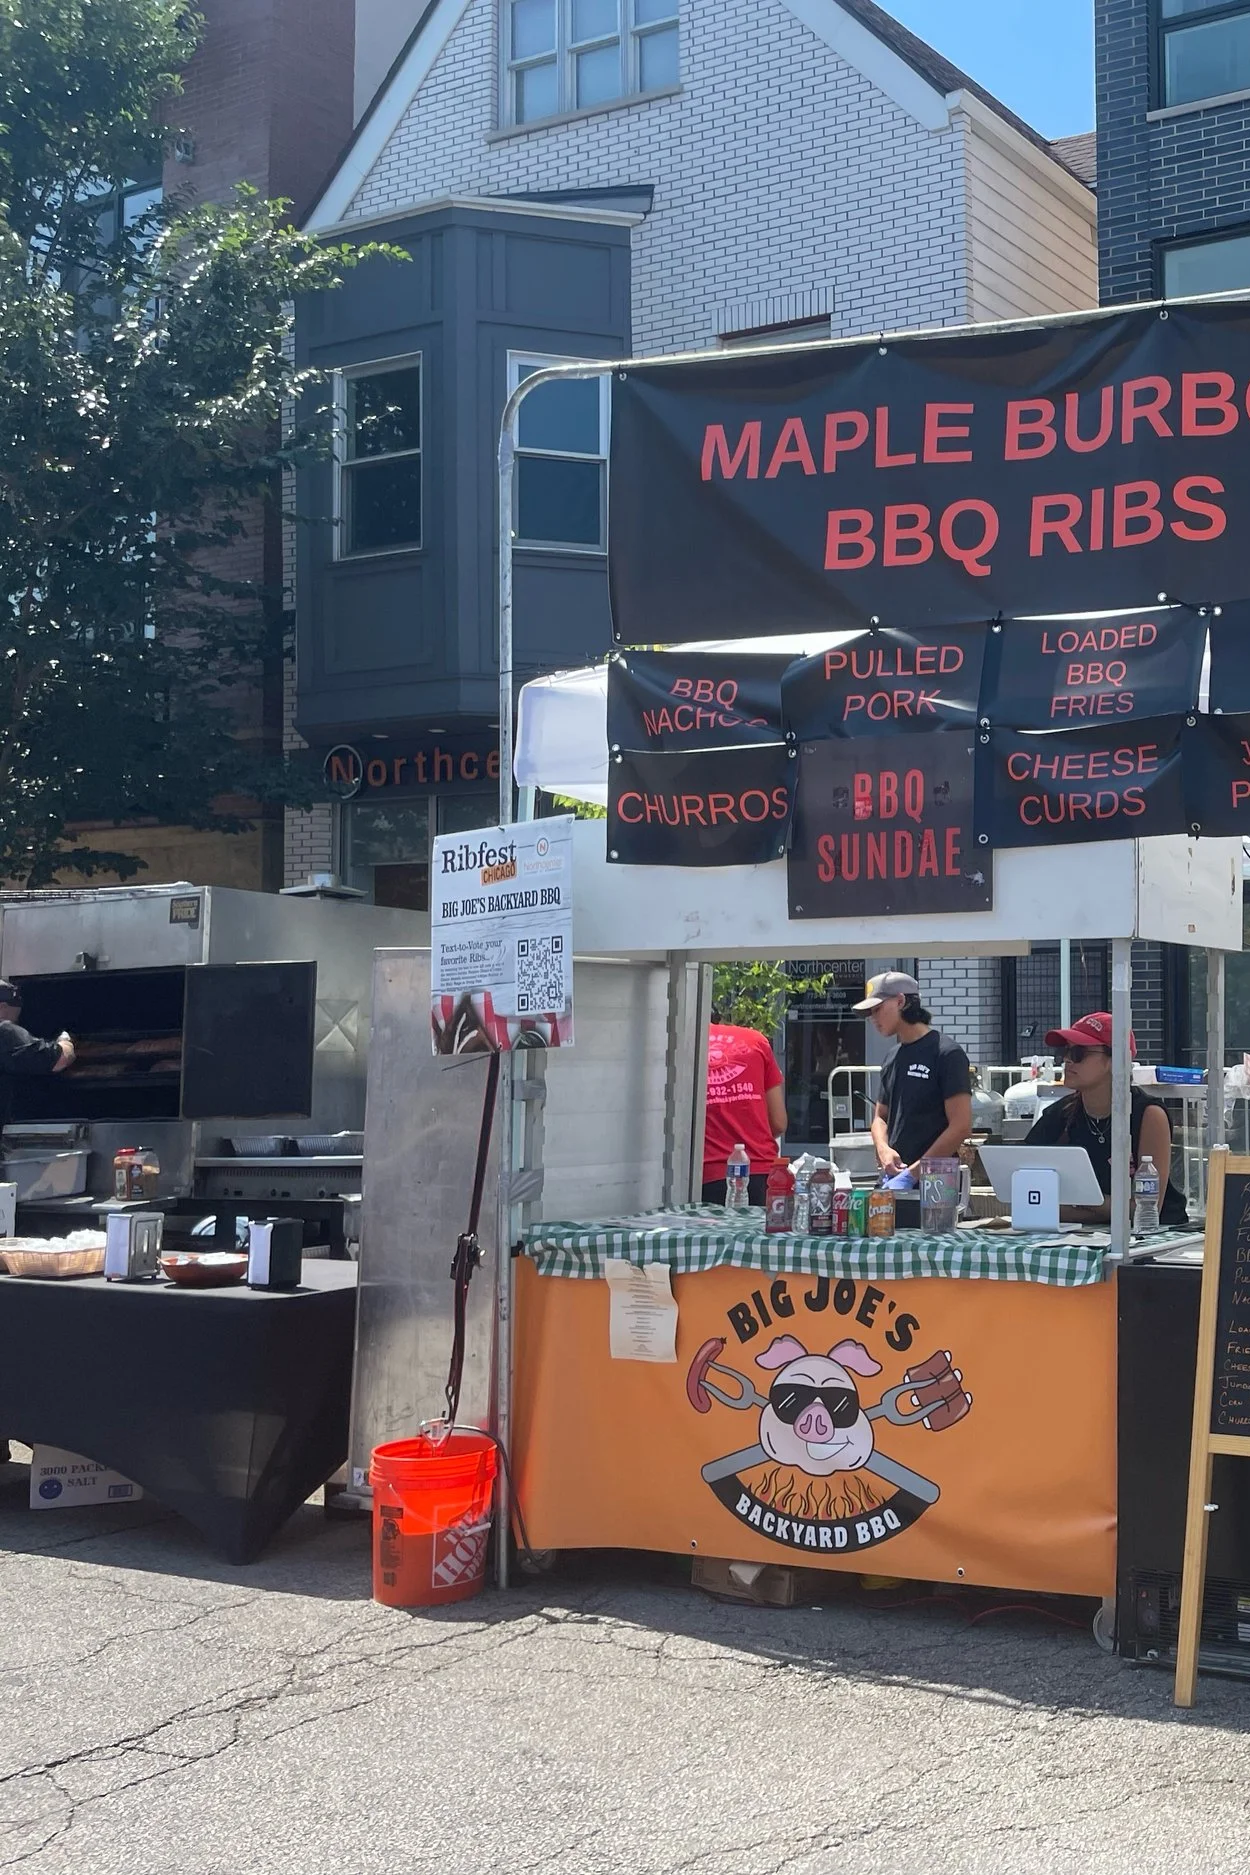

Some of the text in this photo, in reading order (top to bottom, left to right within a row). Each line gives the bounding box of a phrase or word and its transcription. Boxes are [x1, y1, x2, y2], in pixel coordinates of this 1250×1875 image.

[701, 402, 973, 482] MAPLE
[823, 474, 1229, 577] BBQ RIBS
[1041, 624, 1158, 655] LOADED
[824, 646, 965, 682] PULLED
[1066, 659, 1126, 688] BBQ
[669, 678, 739, 711] BBQ
[842, 687, 938, 722] PORK
[1050, 692, 1135, 719] FRIES
[1007, 745, 1159, 782] CHEESE
[617, 788, 789, 826] CHURROS
[853, 769, 925, 822] BBQ
[1018, 787, 1147, 826] CURDS
[441, 840, 517, 874] Ribfest
[817, 828, 962, 883] SUNDAE
[483, 863, 516, 884] CHICAGO
[442, 887, 561, 919] BIG JOE'S BACKYARD BBQ
[440, 955, 467, 966] favorite
[485, 939, 503, 950] your
[868, 1203, 893, 1218] Crush
[726, 1280, 795, 1343] BIG
[804, 1277, 920, 1351] JOE'S
[1219, 1391, 1243, 1408] CORN
[67, 1476, 98, 1488] SALT
[735, 1492, 901, 1548] BACKYARD BBQ
